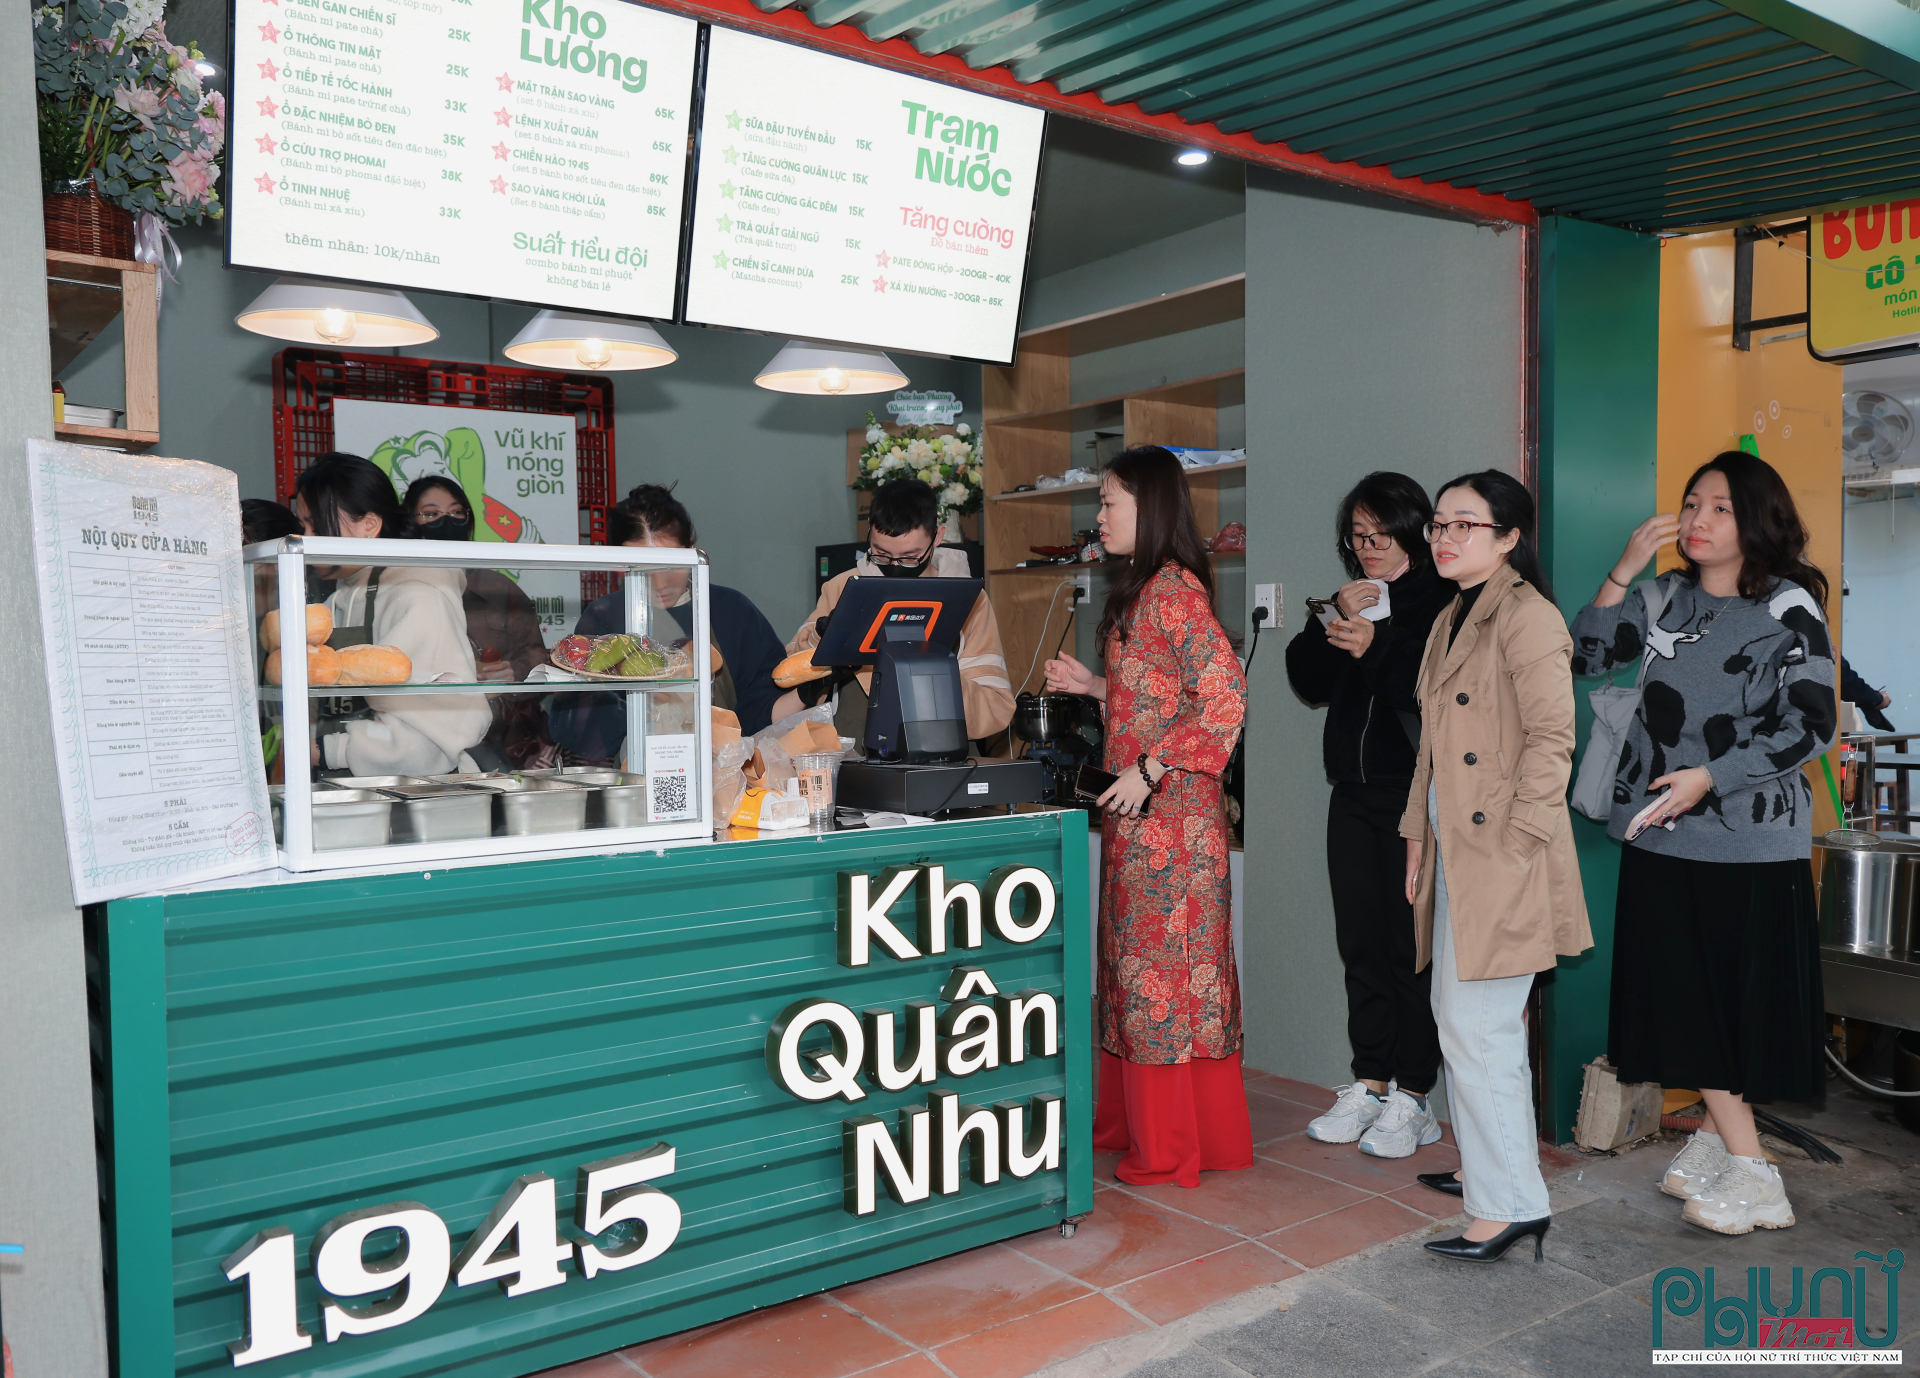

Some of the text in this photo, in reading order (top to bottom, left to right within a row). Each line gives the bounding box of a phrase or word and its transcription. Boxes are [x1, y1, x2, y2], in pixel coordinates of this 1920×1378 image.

[322, 0, 347, 14] GAN
[350, 5, 383, 23] CHIẾN
[386, 13, 396, 25] SĨ
[522, 0, 606, 39] Kho
[284, 25, 382, 61] Ổ THÔNG TIN MẬT
[448, 28, 471, 43] 25K
[446, 64, 470, 78] 25K
[521, 28, 647, 93] Lương
[283, 62, 393, 98] Ổ TIẾP TẾ TỐC HÀNH
[444, 99, 467, 114] 33K
[517, 80, 615, 109] MẶT TRẬN SAO VÀNG
[282, 99, 396, 135] Ổ ĐẶC NHIỆM BÒ ĐEN
[655, 107, 675, 120] 65K
[515, 114, 599, 139] LỆNH XUẤT QUÂN
[745, 117, 836, 145] SỮA ĐẬU TUYẾN ĐẦU
[280, 136, 386, 169] Ổ CỨU TRỢ PHOMAI
[443, 134, 466, 148] 35K
[652, 141, 672, 153] 65K
[856, 138, 873, 151] 15K
[513, 147, 589, 171] CHIẾN HÀO 1945
[742, 151, 847, 183] TĂNG CƯỜNG QUÂN LỰC
[441, 169, 463, 183] 38K
[650, 173, 669, 185] 89K
[852, 172, 869, 185] 15K
[915, 147, 1012, 197] Nước
[279, 175, 350, 203] Ổ TINH NHUỆ
[511, 182, 606, 207] SAO VÀNG KHÓI LỬA
[739, 186, 838, 213] TĂNG CƯỜNG GÁC ĐÊM
[439, 206, 462, 220] 33K
[647, 205, 666, 217] 85K
[848, 205, 865, 218] 15K
[755, 221, 779, 237] QUẤT
[899, 205, 1014, 249] Tăng cường
[285, 232, 441, 265] thêm nhân: 10k/nhân
[513, 231, 648, 271] Suất tiểu đội
[845, 238, 861, 250] 15K
[965, 243, 989, 256] thêm
[526, 257, 559, 270] combo
[562, 262, 587, 273] bánh
[732, 254, 814, 278] CHIẾN SĨ CANH DỪA
[893, 256, 911, 267] PATE
[913, 258, 936, 272] ĐÓNG
[938, 264, 954, 276] HỘP
[995, 274, 1011, 284] 40K
[1866, 255, 1905, 290] CÔ
[547, 274, 579, 288] không
[581, 279, 600, 290] bán
[731, 270, 803, 289] (Matcha coconut)
[841, 274, 860, 286] 25K
[918, 284, 947, 298] NƯỚNG
[988, 297, 1003, 307] 85K
[1884, 289, 1918, 306] món
[494, 428, 566, 451] Vũ khí
[506, 451, 564, 477] nóng
[516, 476, 564, 498] giòn
[133, 510, 158, 522] 1945
[81, 526, 208, 555] NỘI QUY CỬA HÀNG
[840, 862, 1057, 968] Kho
[768, 966, 1059, 1103] Quân
[846, 1088, 1062, 1218] Nhu
[221, 1142, 682, 1366] 1945
